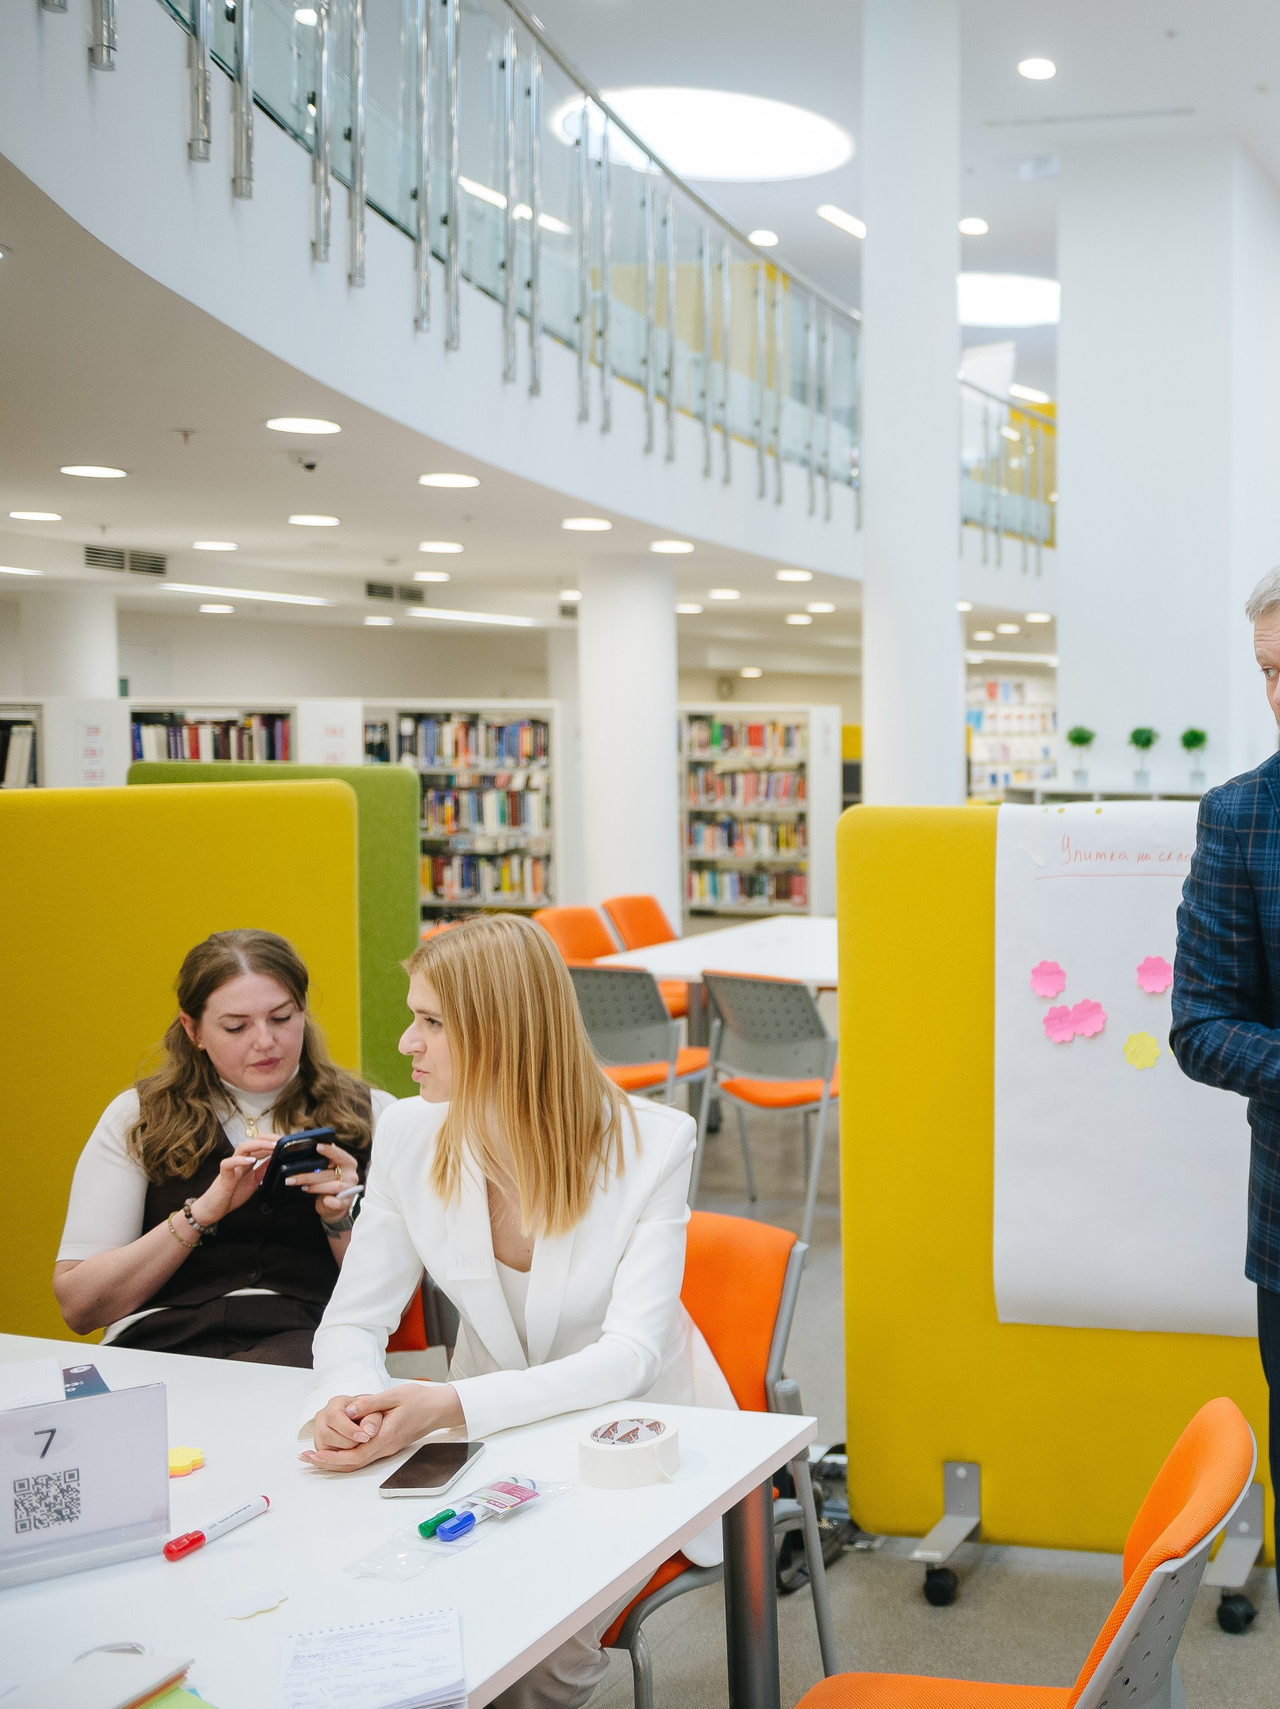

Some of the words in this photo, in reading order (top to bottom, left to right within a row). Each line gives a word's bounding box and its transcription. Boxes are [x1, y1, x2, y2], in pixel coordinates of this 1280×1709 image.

[1060, 832, 1129, 866] Улитка
[1136, 850, 1152, 862] на
[34, 1428, 57, 1459] 7
